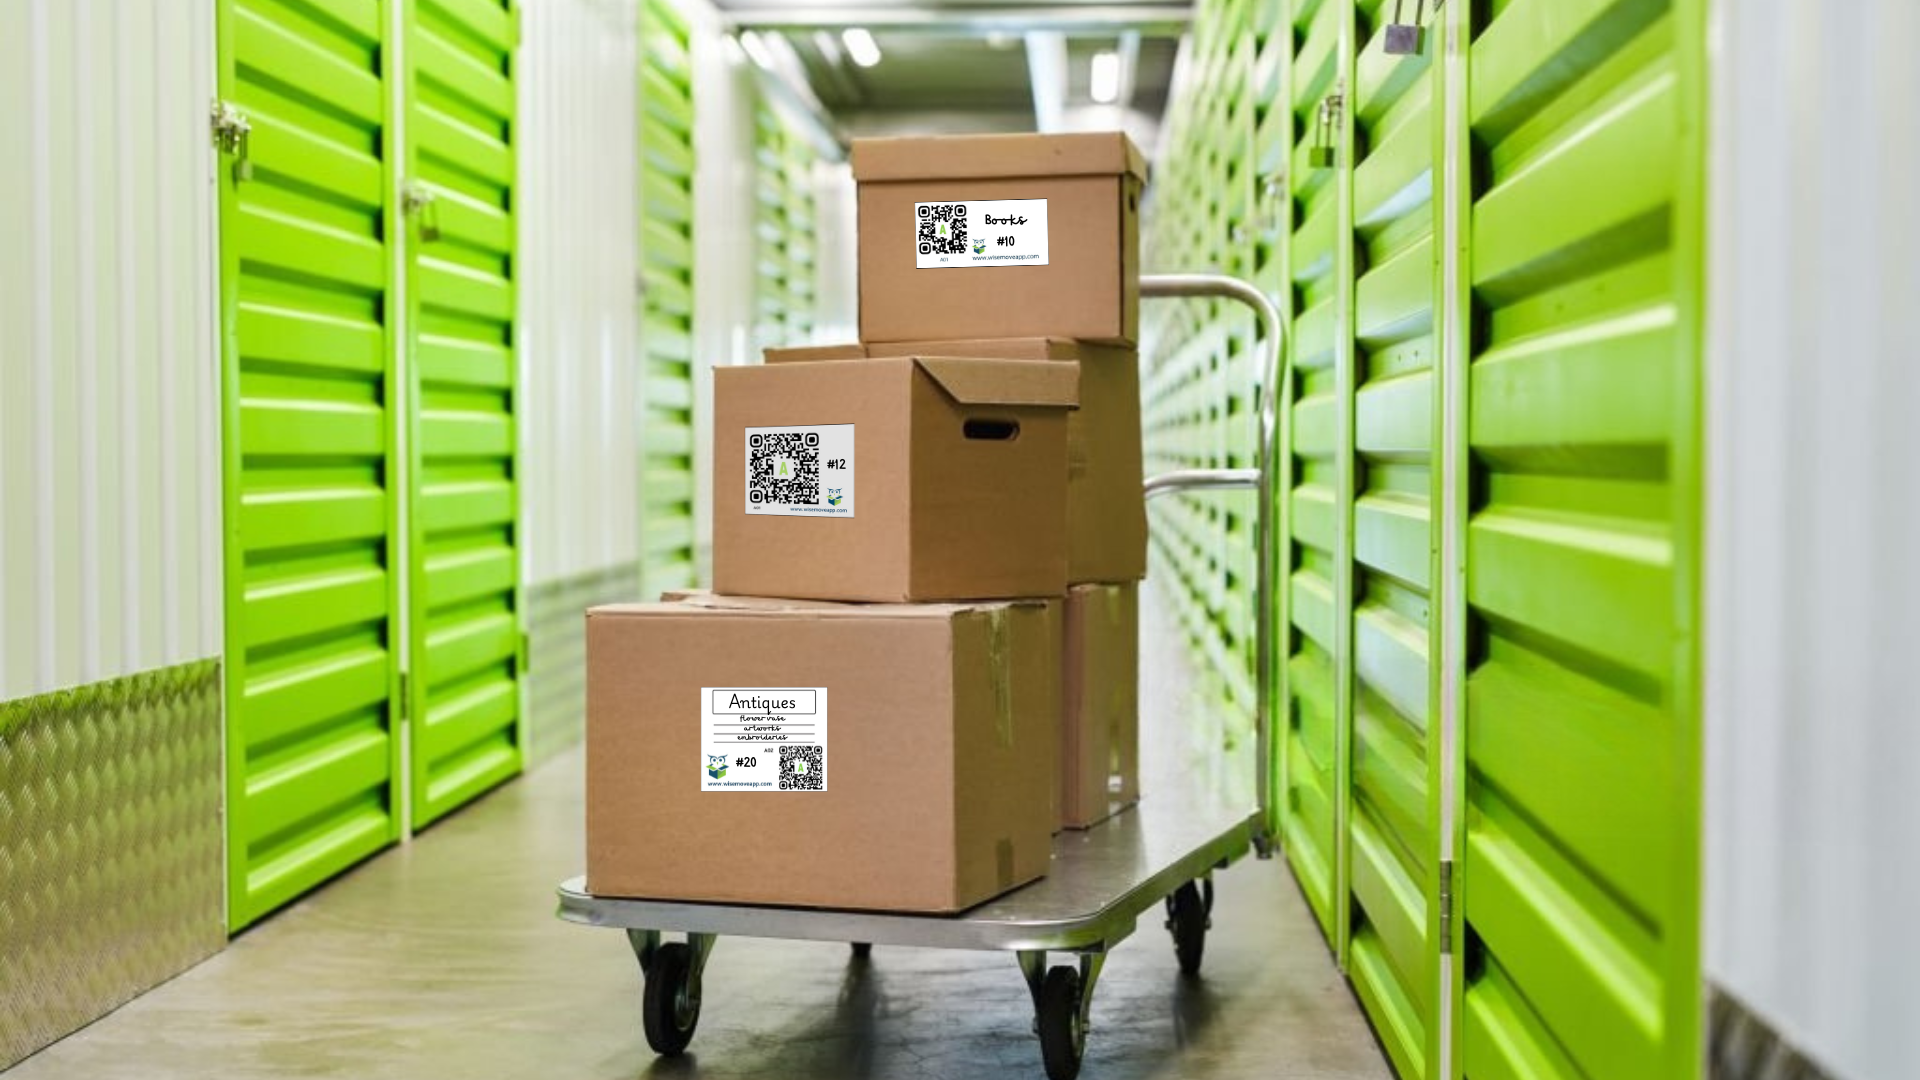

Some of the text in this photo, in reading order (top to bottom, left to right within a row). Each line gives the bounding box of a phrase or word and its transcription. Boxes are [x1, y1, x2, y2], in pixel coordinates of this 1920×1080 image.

[985, 214, 1028, 226] Books
[996, 235, 1015, 247] #10
[972, 253, 1040, 261] www.wisemoveapp.com
[779, 461, 789, 476] A
[827, 458, 847, 470] #12
[729, 693, 796, 715] Antiques
[735, 756, 757, 768] #20
